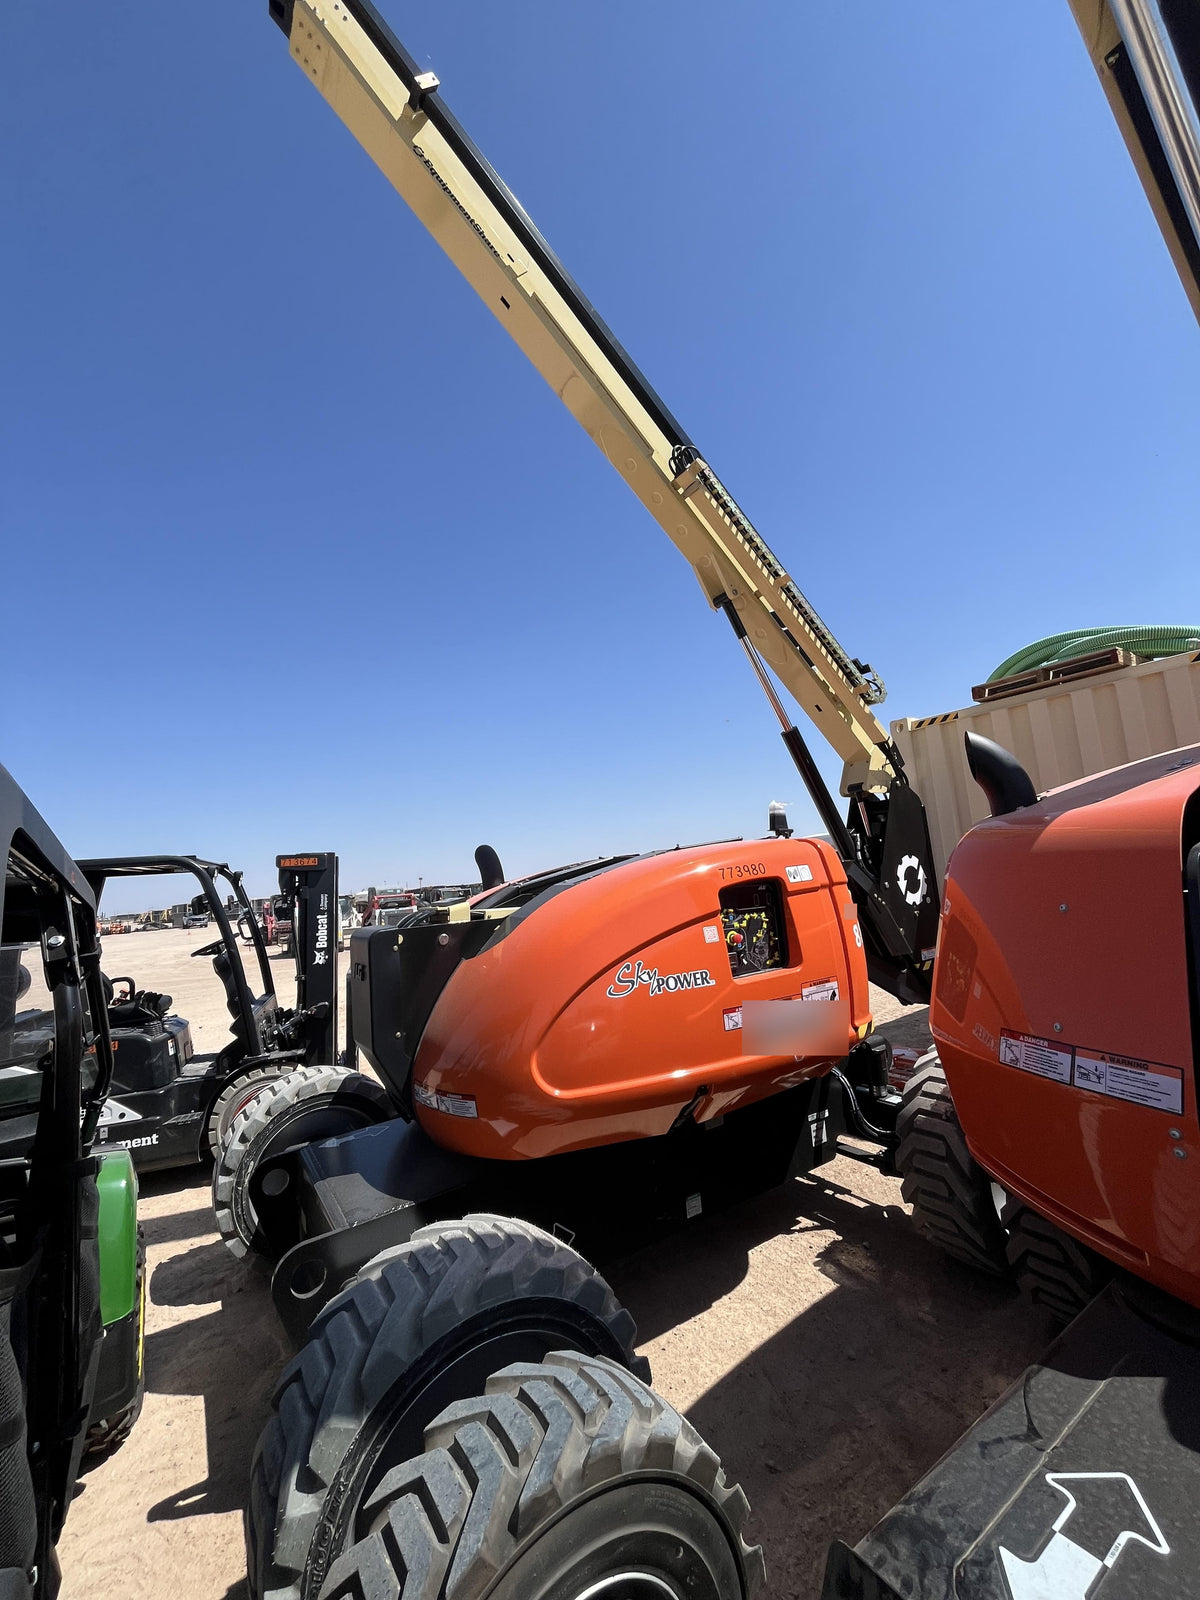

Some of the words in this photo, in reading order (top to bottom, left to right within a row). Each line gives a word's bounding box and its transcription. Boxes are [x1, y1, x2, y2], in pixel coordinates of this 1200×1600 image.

[423, 158, 500, 258] EquipmentShare
[282, 858, 317, 866] 713674
[718, 863, 766, 880] 773980
[316, 914, 328, 948] Bobcat
[606, 960, 658, 998] Sky
[654, 970, 711, 994] POWER
[1024, 1036, 1049, 1048] DANGER
[1108, 1055, 1149, 1070] WARNING
[118, 1133, 159, 1149] ment
